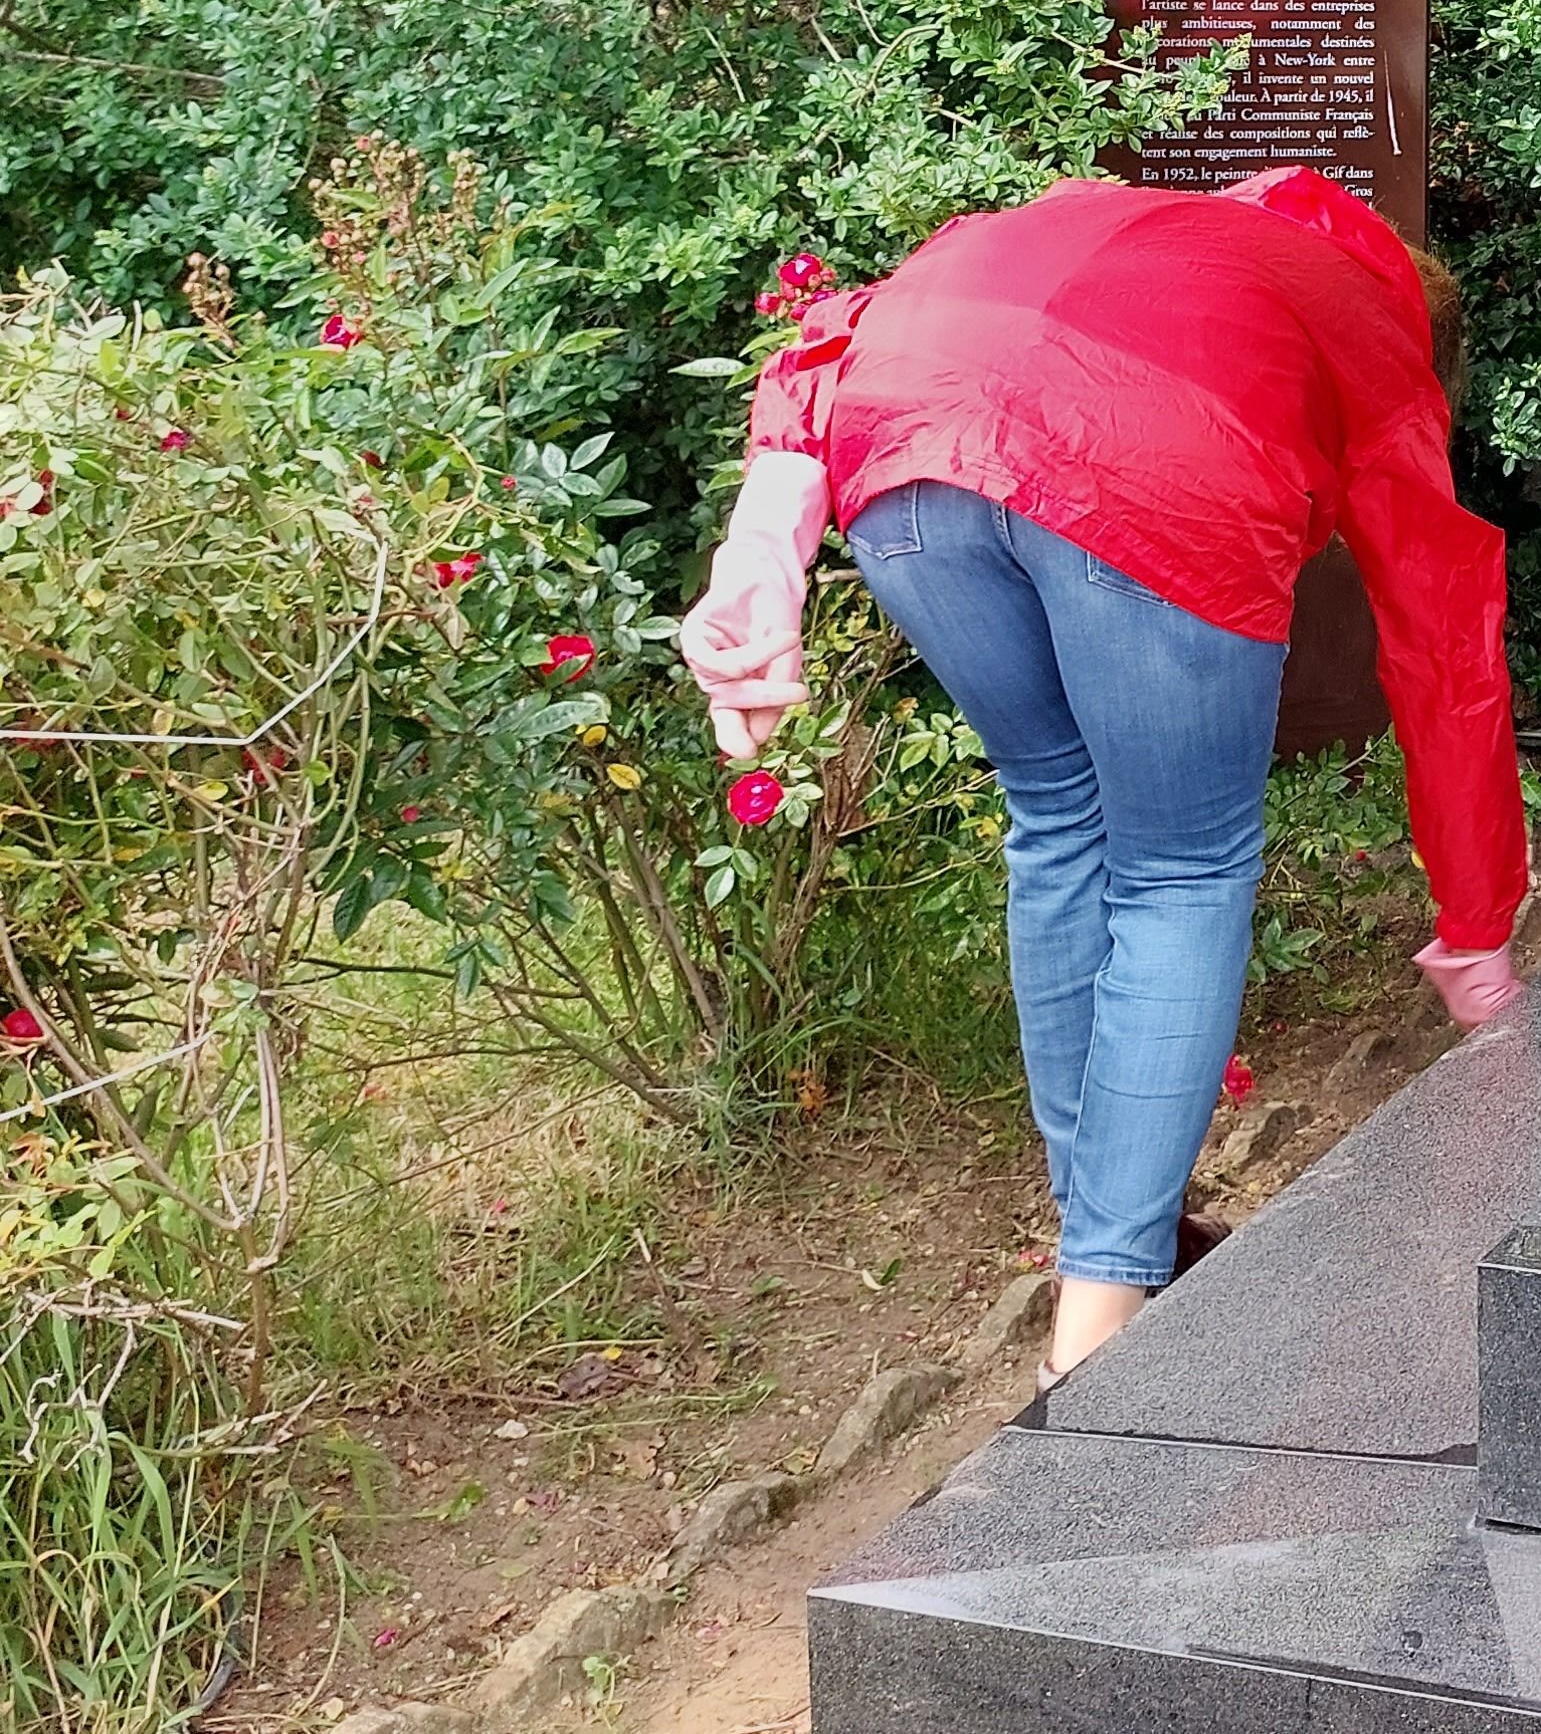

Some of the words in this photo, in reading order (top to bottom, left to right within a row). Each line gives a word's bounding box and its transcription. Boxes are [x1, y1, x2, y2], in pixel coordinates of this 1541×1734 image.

[1193, 1, 1206, 10] se
[1213, 0, 1244, 10] lance
[1250, 0, 1278, 10] dans
[1285, 0, 1305, 11] des
[1311, 1, 1374, 14] entreprises
[1182, 17, 1256, 29] ambitieuses,
[1271, 19, 1341, 29] notamment
[1355, 17, 1374, 29] des
[1321, 36, 1374, 48] destinées
[1259, 55, 1266, 66] à
[1275, 54, 1336, 67] New-York
[1344, 56, 1375, 66] entre
[1243, 73, 1251, 84] il
[1259, 73, 1303, 85] invente
[1311, 75, 1326, 85] un
[1334, 73, 1374, 84] nouvel
[1260, 88, 1270, 102] À
[1275, 91, 1307, 106] partir
[1310, 91, 1325, 102] de
[1328, 92, 1362, 105] 1945,
[1366, 91, 1373, 102] il
[1241, 109, 1320, 121] Communiste
[1326, 109, 1373, 125] Français
[1142, 129, 1153, 139] et
[1204, 127, 1223, 139] des
[1230, 127, 1310, 144] compositions
[1317, 127, 1336, 144] qui
[1142, 146, 1166, 158] tent
[1169, 148, 1190, 157] son
[1194, 148, 1266, 161] engagement
[1271, 146, 1337, 158] humaniste.
[1142, 169, 1158, 180] En
[1163, 168, 1198, 181] 1952,
[1201, 169, 1213, 179] le
[1323, 168, 1343, 179] Gif
[1346, 168, 1373, 179] dans
